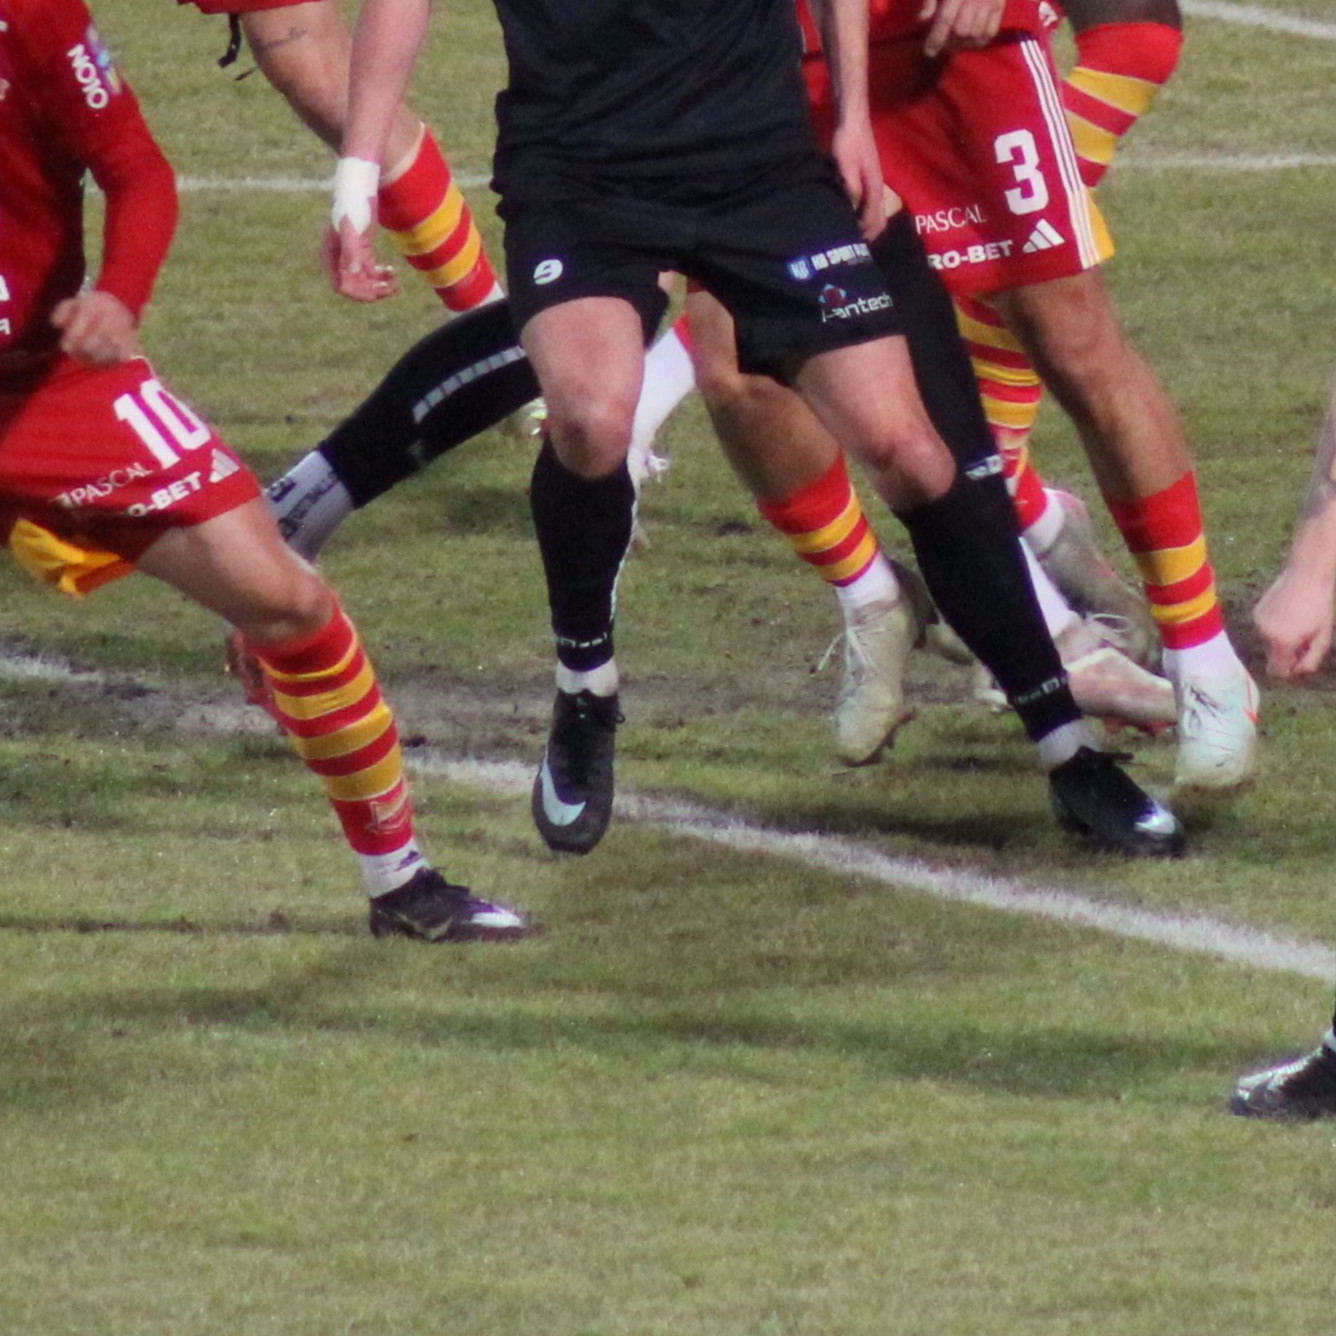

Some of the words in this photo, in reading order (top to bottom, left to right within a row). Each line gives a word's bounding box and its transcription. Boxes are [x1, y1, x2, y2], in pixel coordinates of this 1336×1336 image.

[994, 129, 1049, 215] 3
[915, 204, 987, 235] PASCAL
[113, 379, 211, 469] 10
[71, 462, 153, 506] PASCAL
